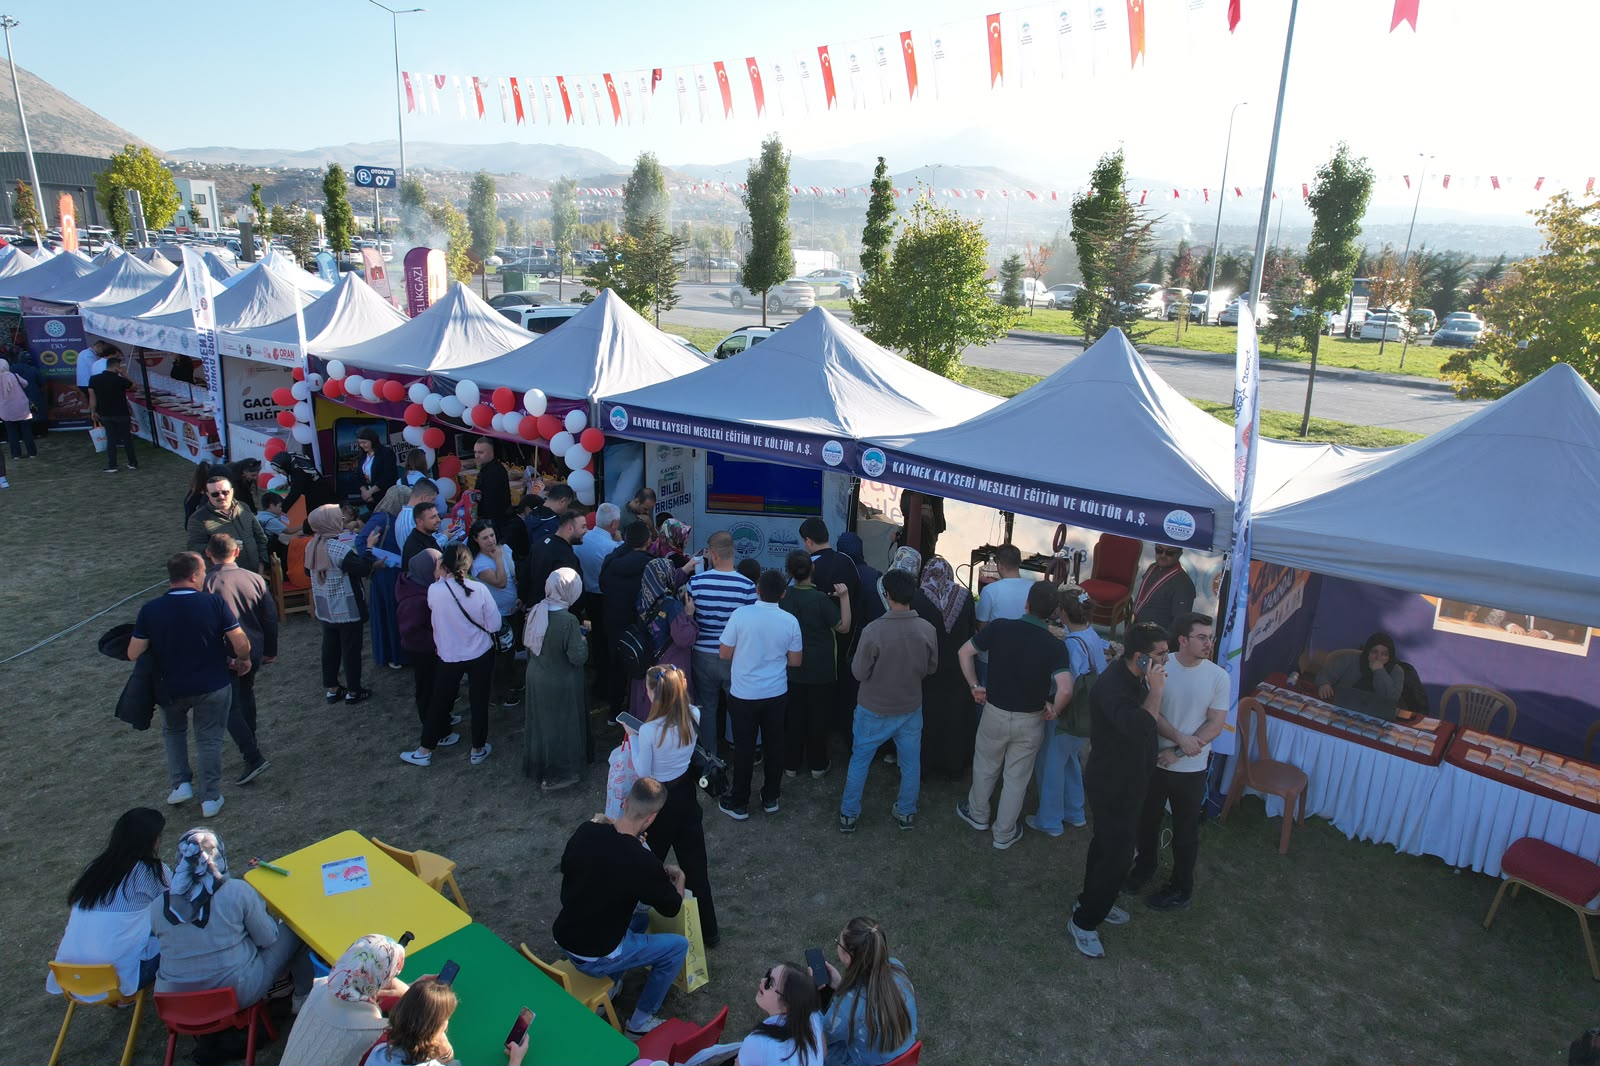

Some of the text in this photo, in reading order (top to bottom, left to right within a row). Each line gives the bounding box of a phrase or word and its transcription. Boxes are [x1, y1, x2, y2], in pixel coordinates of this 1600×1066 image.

[370, 168, 394, 176] OTOPARK
[375, 175, 390, 186] 07
[279, 348, 295, 359] ORAN
[632, 416, 812, 456] KAYMEK KAYSERİ MESLEKİ EĞİTİM VE KÜLTÜR A.Ş.
[892, 461, 1148, 527] KAYMEK KAYSERİ MESLEKİ EĞİTİM VE KÜLTÜR A.Ş.
